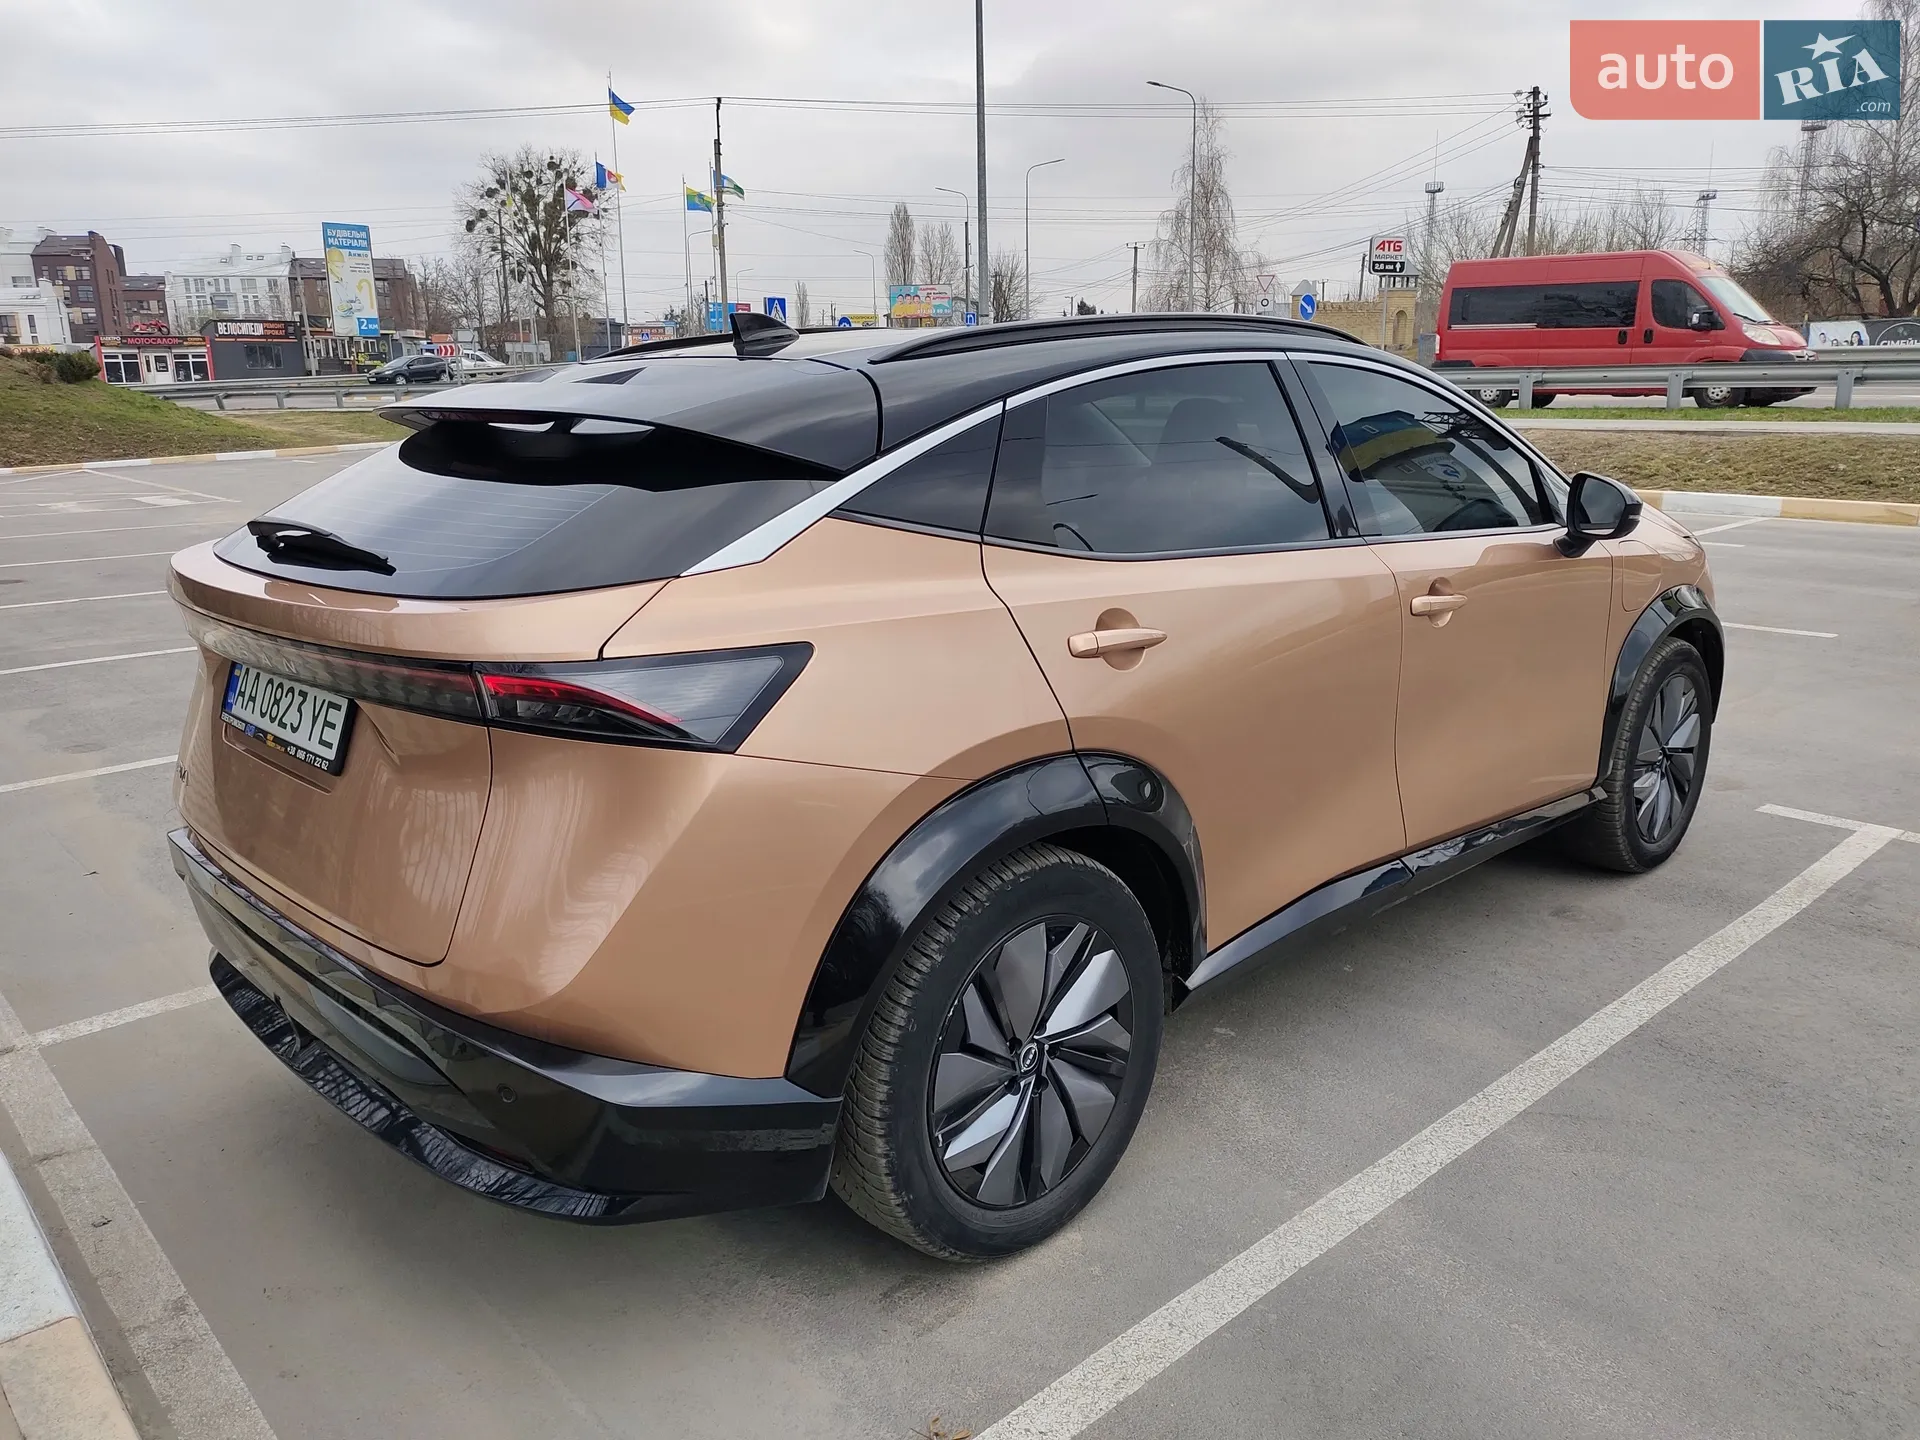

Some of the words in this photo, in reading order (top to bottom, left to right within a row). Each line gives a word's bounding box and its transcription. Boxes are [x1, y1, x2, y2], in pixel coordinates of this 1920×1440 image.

[327, 229, 367, 239] БУДІВЕЛЬНІ
[328, 238, 368, 248] МАТЕРІАЛИ
[217, 322, 264, 335] ВЕЛОСИПЕДИ
[360, 319, 368, 330] 2
[235, 667, 261, 715] AA
[259, 677, 308, 734] 0823
[308, 695, 343, 750] YE
[314, 757, 322, 768] 22
